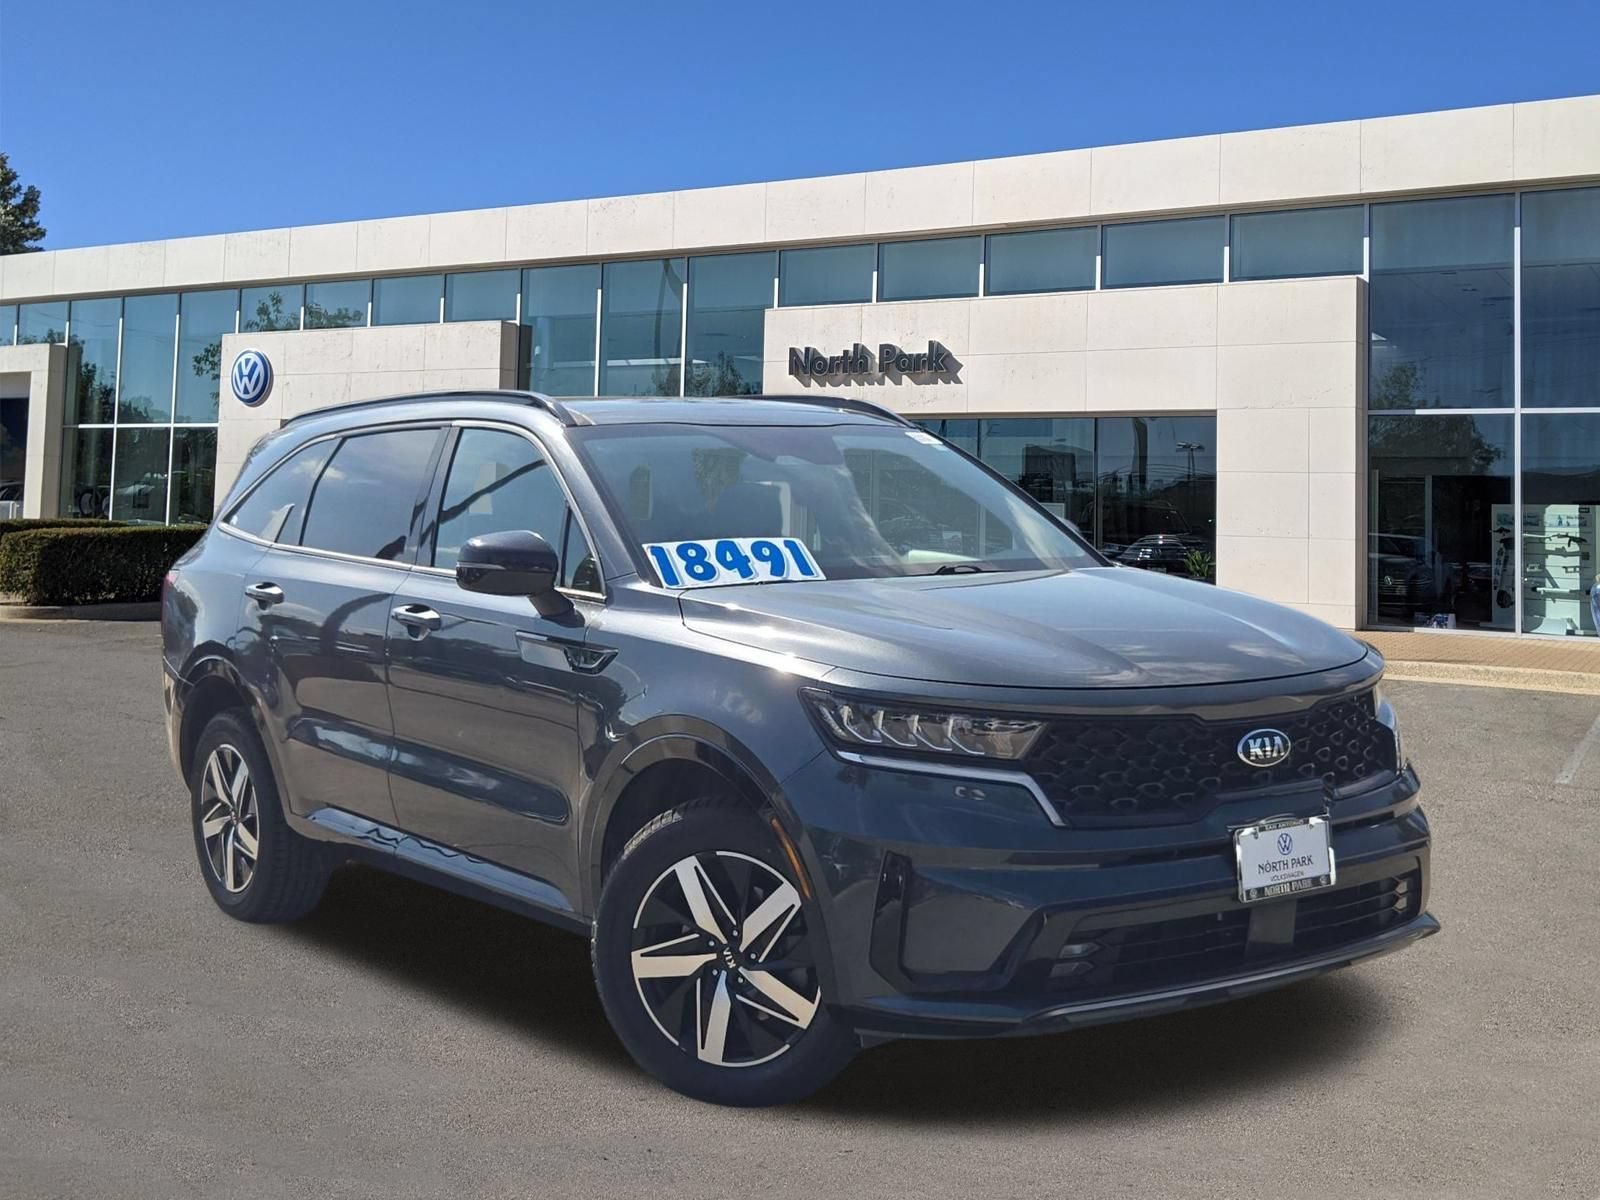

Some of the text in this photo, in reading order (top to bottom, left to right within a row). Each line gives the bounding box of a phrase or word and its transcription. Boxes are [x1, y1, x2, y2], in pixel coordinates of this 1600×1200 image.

[788, 340, 949, 376] North Park
[649, 540, 815, 587] 18491
[1248, 736, 1285, 760] KIA
[1258, 855, 1314, 874] NORTH PARK
[1264, 882, 1290, 896] NORTH
[1292, 878, 1313, 891] PARK
[723, 947, 736, 968] KIA
